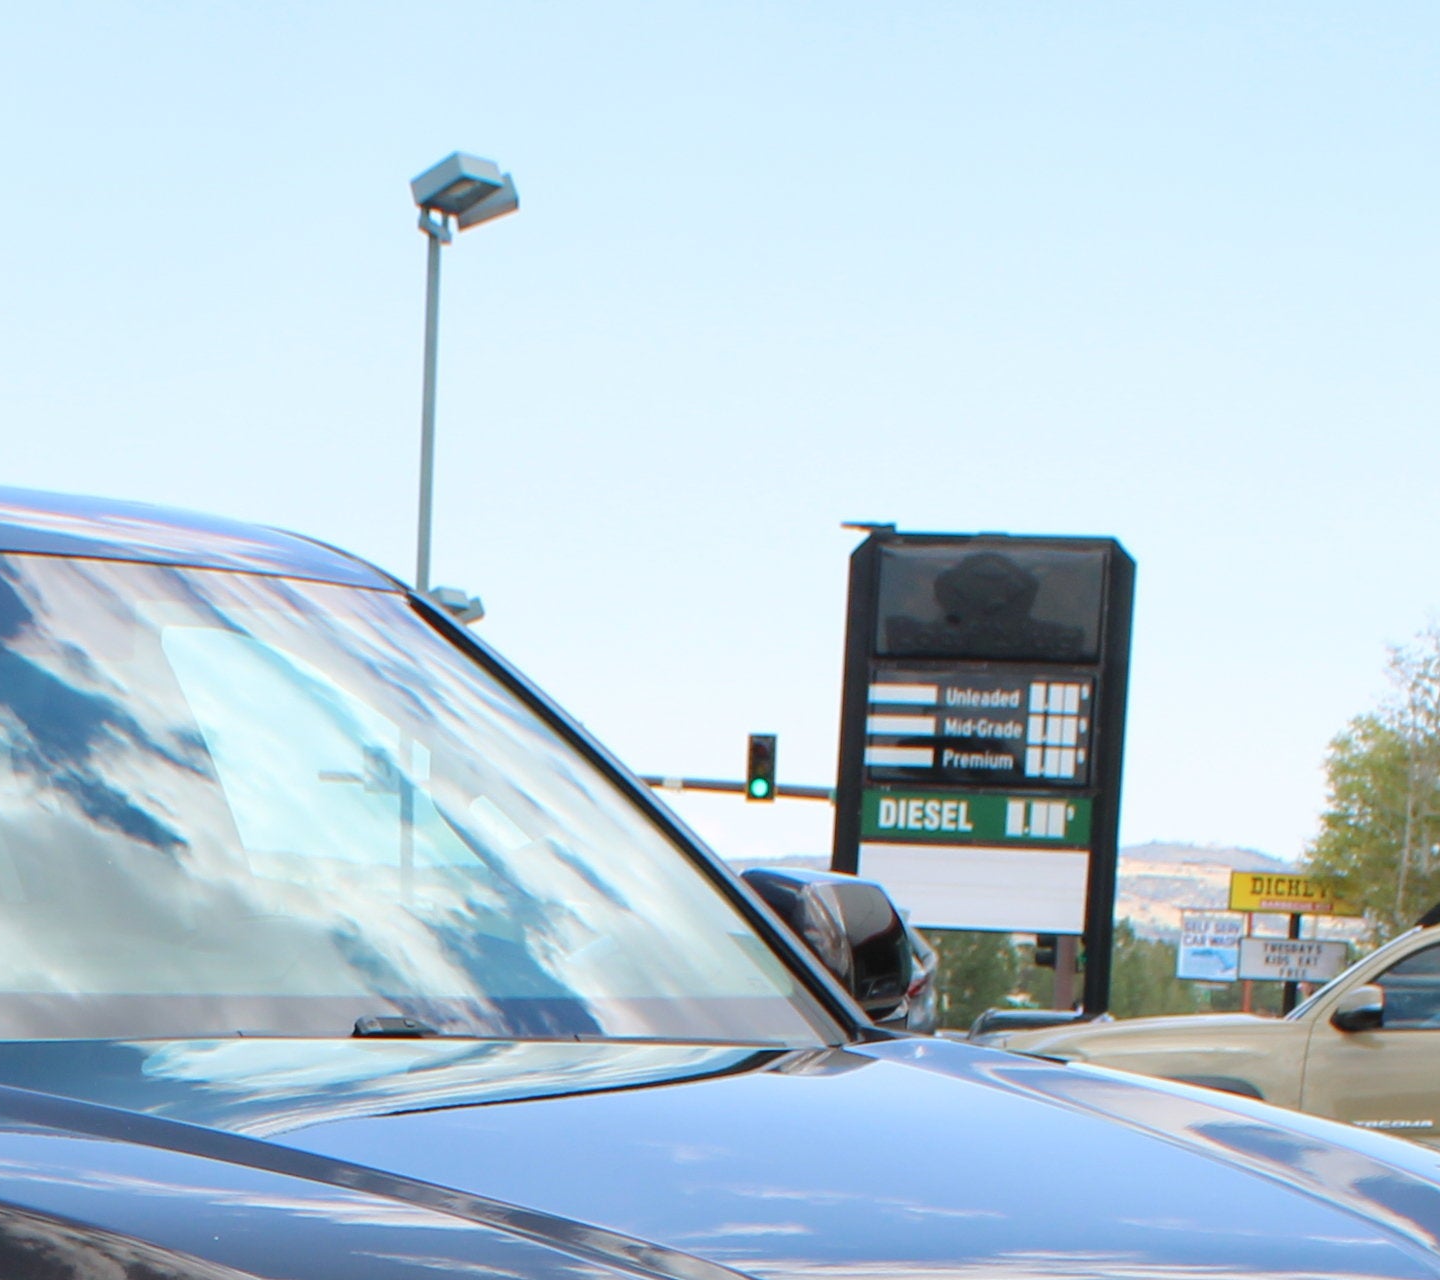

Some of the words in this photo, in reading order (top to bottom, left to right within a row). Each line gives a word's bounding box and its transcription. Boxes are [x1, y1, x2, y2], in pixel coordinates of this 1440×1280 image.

[945, 687, 1019, 708] Unleaded
[944, 717, 1023, 738] Mid-Grade
[942, 749, 1014, 770] Premium
[878, 797, 974, 832] DIESEL
[1184, 933, 1207, 946] CAR
[1264, 954, 1290, 966] KIDS
[1297, 955, 1319, 967] EAT
[1279, 966, 1308, 978] FREE
